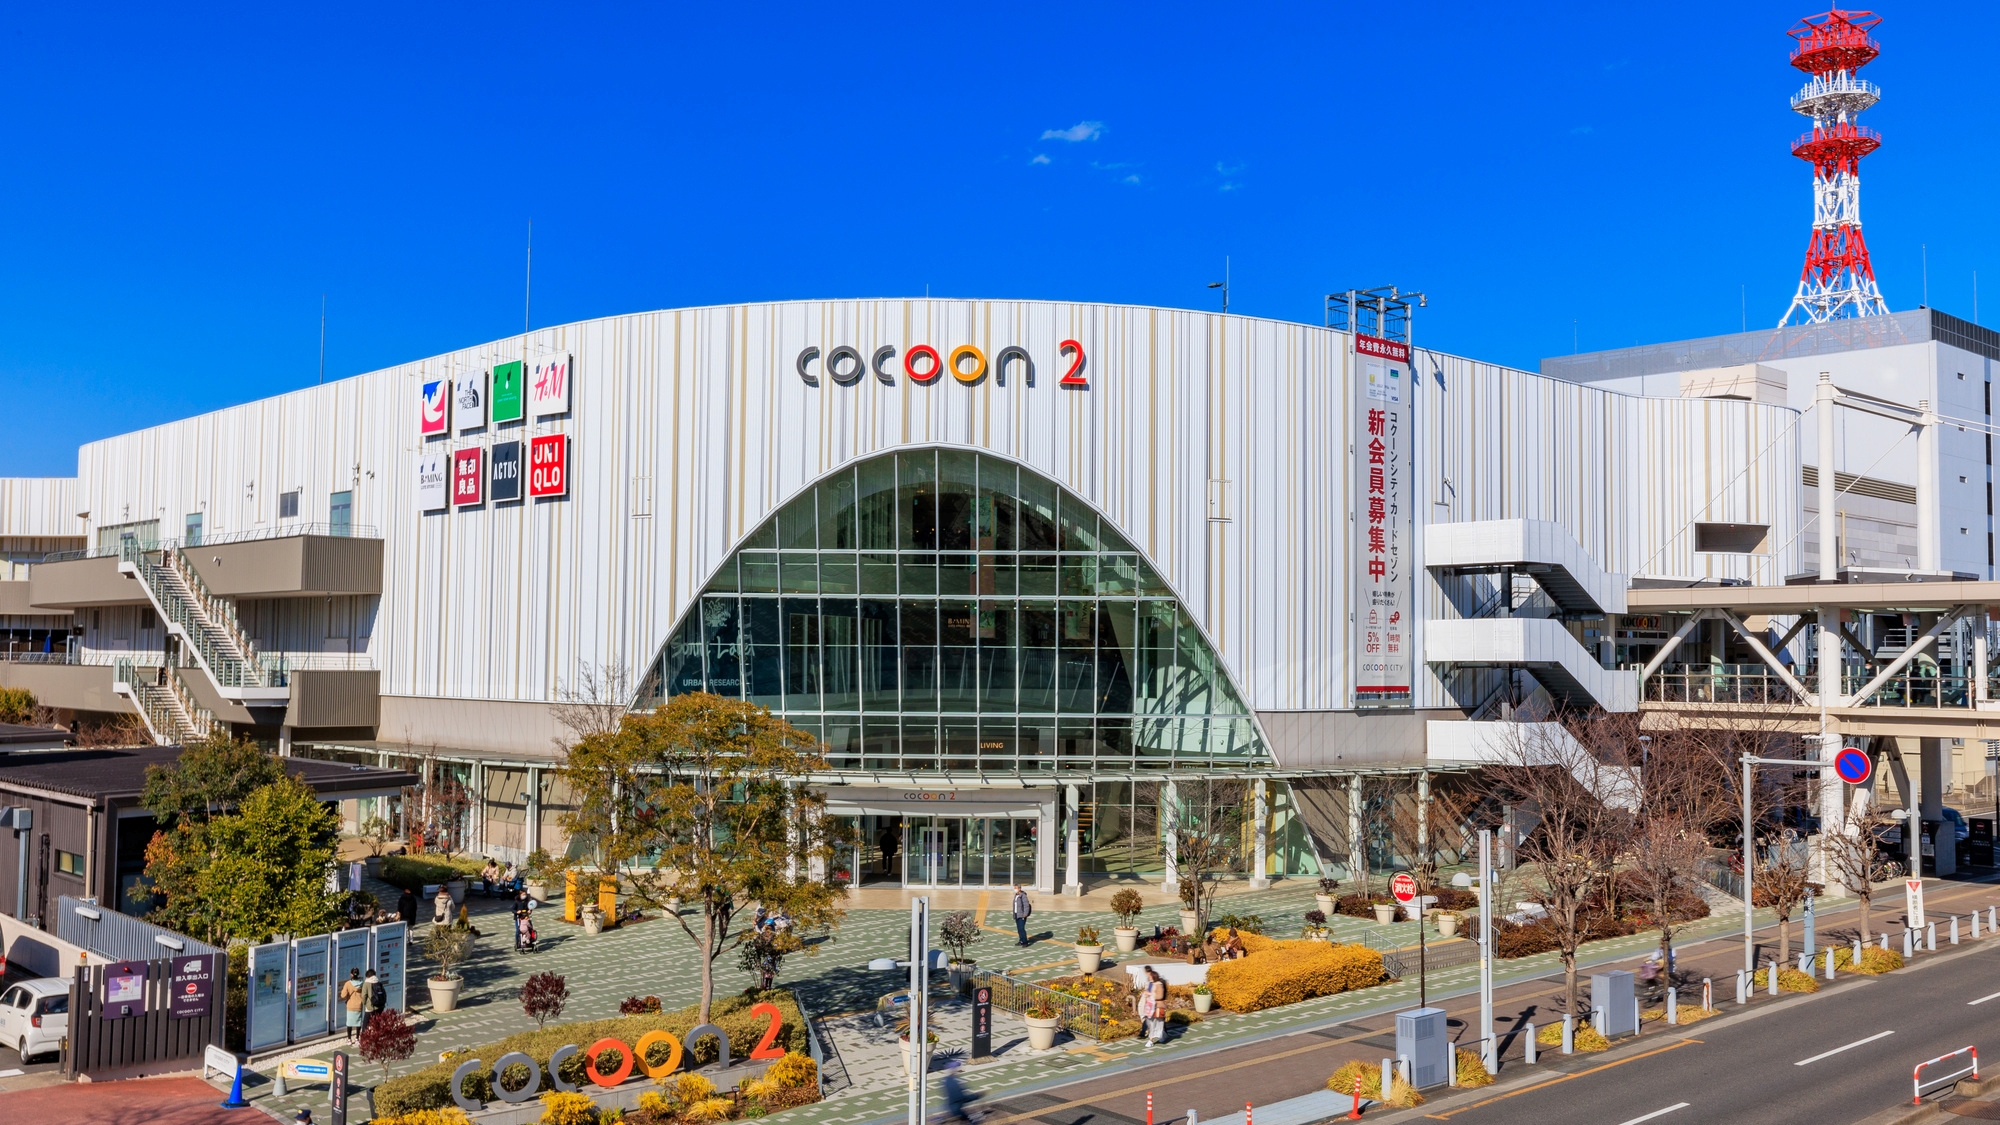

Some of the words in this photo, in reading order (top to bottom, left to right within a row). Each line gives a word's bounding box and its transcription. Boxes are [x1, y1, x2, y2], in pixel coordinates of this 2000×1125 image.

[1359, 340, 1405, 358] 年会費永久無料
[1059, 339, 1086, 384] 2
[534, 363, 565, 402] H&M
[534, 442, 558, 464] UNI
[458, 458, 476, 476] 無印
[493, 460, 517, 480] ACTUS
[458, 478, 476, 495] 良品
[533, 466, 560, 491] QLO
[1368, 408, 1386, 583] 新会員募集中
[1390, 412, 1398, 583] コクーンシティカードセゾン
[1367, 631, 1379, 643] 5%
[1386, 632, 1400, 643] 1時間
[1366, 643, 1380, 653] OFF
[1387, 643, 1399, 653] 無料
[683, 679, 703, 687] URBA
[709, 679, 741, 687] RESEARC
[949, 791, 956, 800] 2
[1395, 883, 1414, 894] 消火栓
[751, 1002, 785, 1059] 2
